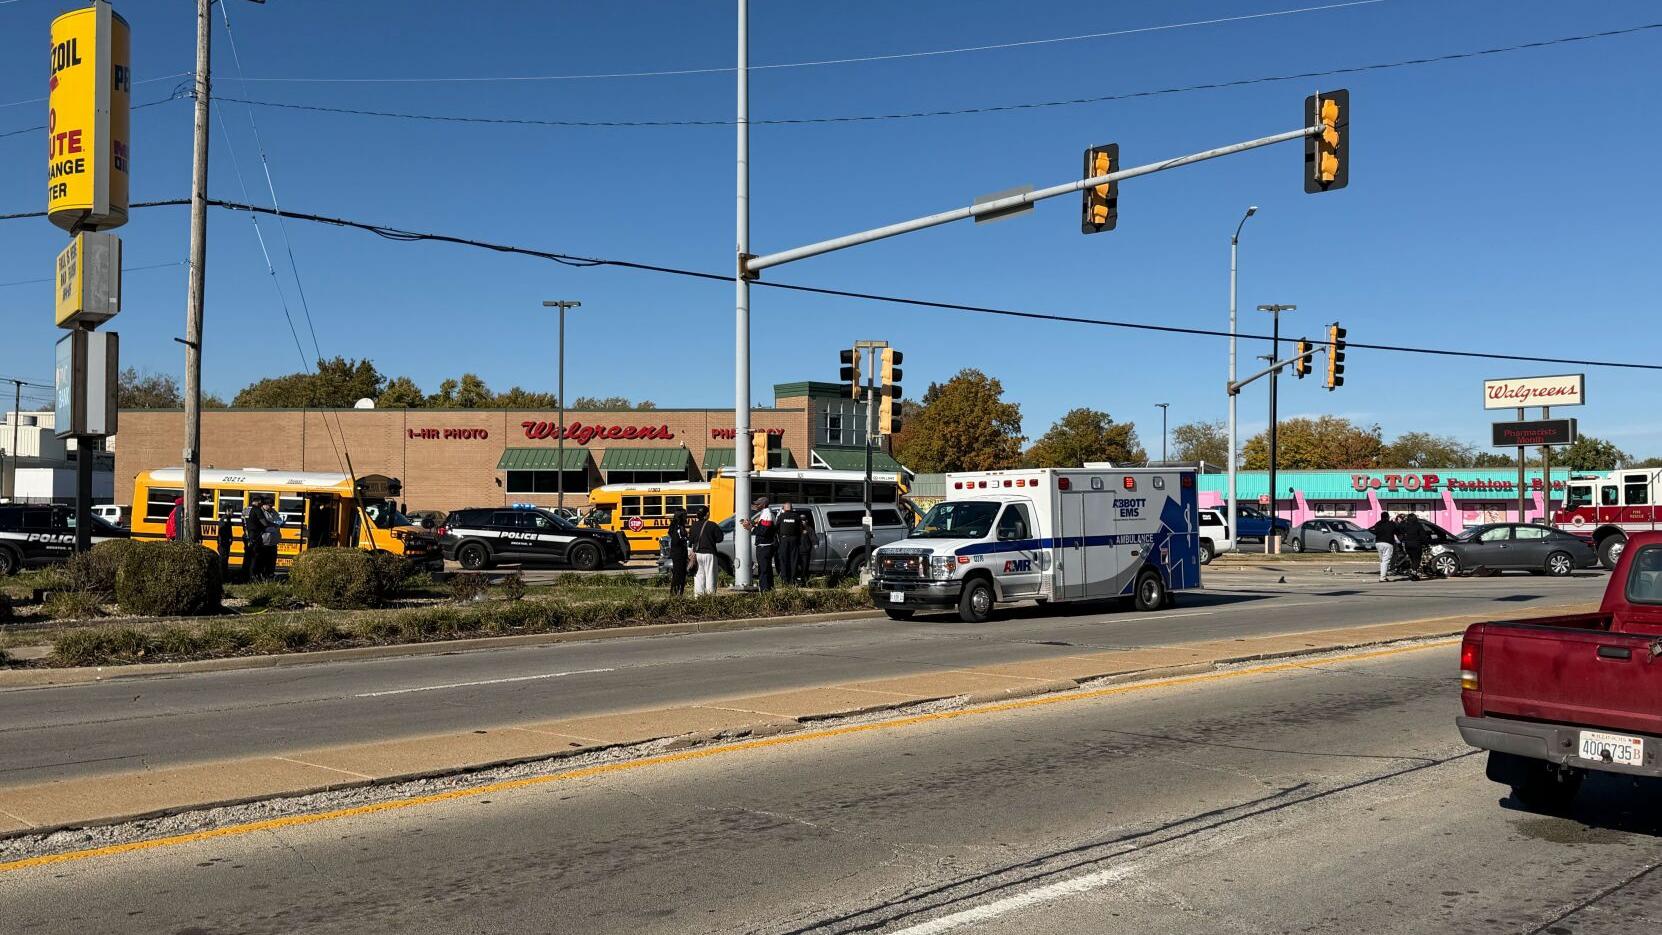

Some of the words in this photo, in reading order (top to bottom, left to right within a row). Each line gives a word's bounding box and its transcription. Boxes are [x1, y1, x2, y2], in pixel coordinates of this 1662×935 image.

[1487, 384, 1578, 403] Walgreens
[443, 428, 489, 440] PHOTO
[521, 421, 674, 445] Walgreens
[1112, 499, 1146, 508] ABBOTT
[1120, 508, 1139, 517] EMS
[500, 531, 538, 540] POLICE
[1116, 534, 1153, 544] AMBULANCE
[1003, 560, 1031, 572] AMR
